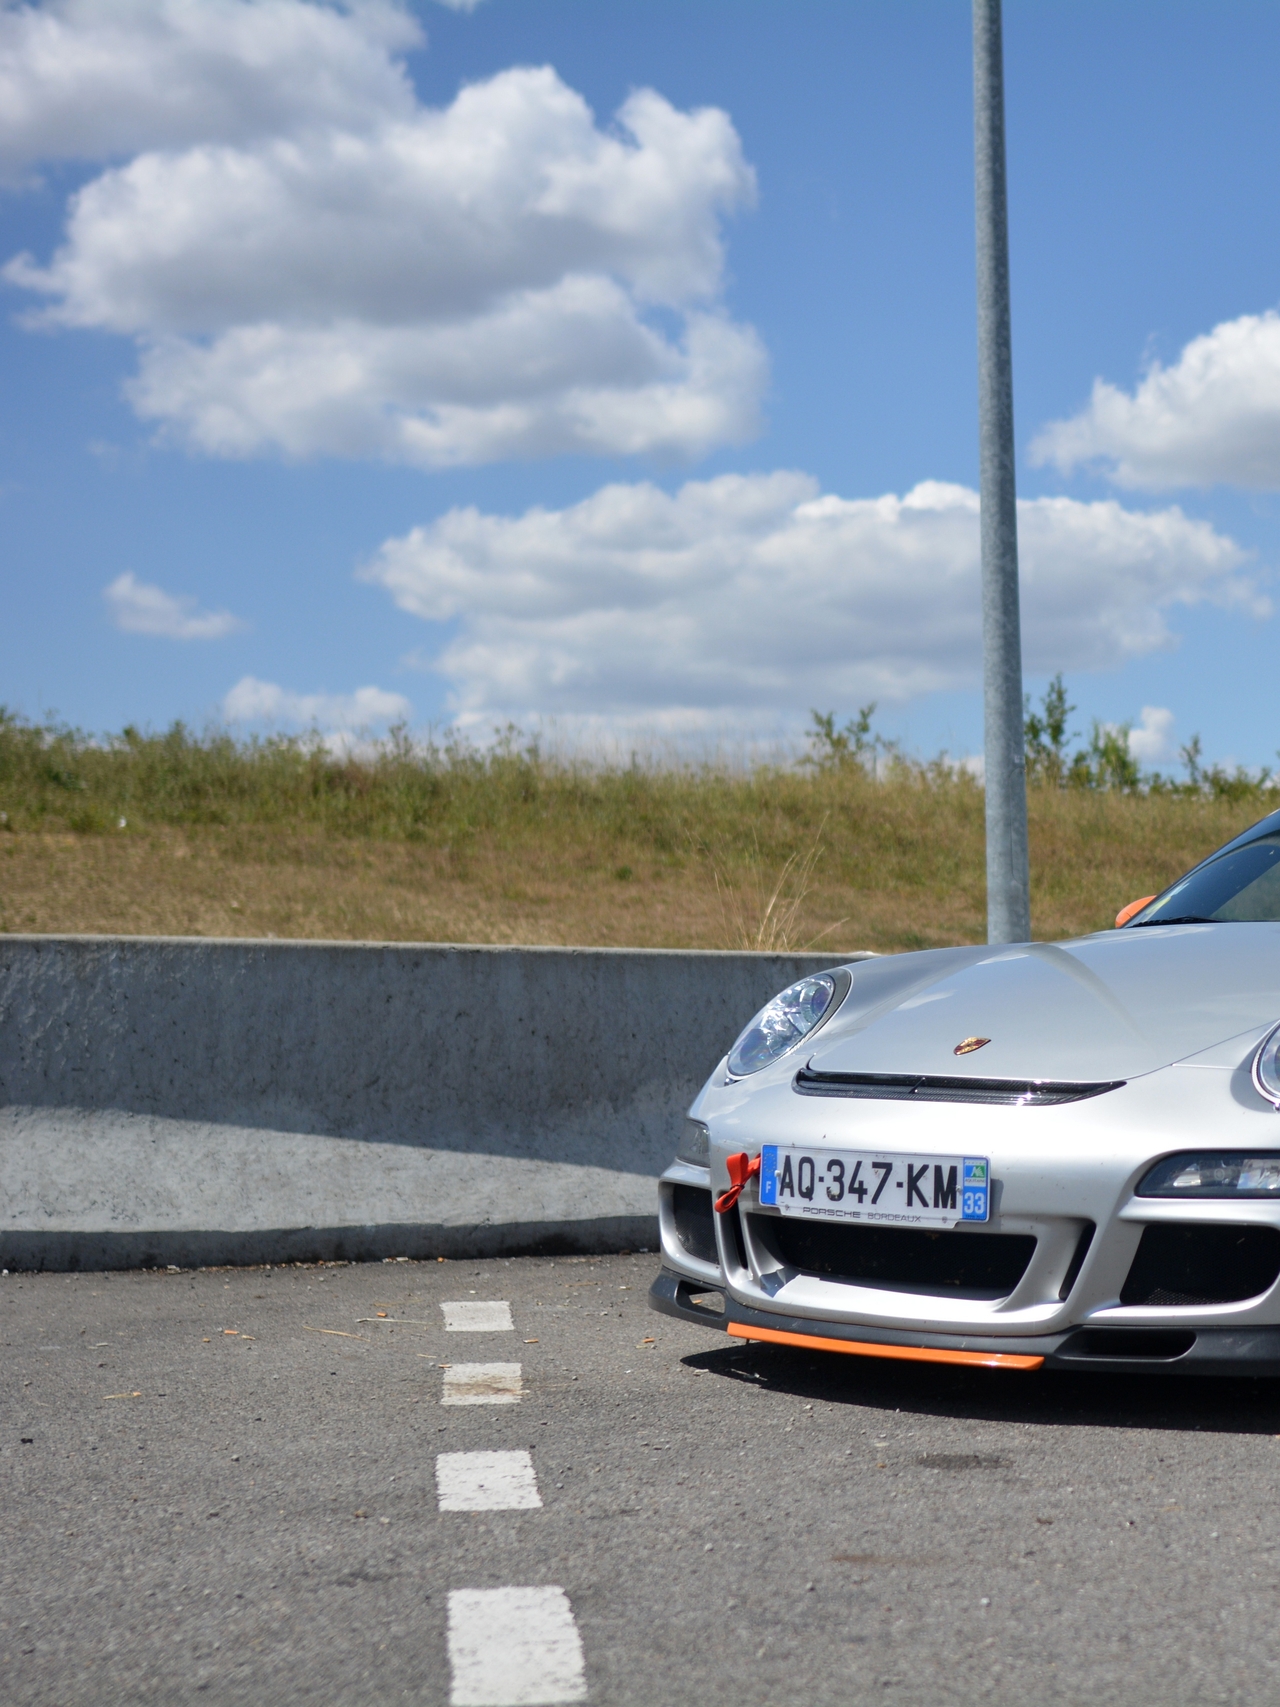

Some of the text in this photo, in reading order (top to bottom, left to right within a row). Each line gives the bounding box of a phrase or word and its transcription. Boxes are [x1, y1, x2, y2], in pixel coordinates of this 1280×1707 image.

[765, 1181, 772, 1194] F
[964, 1192, 985, 1214] 33
[802, 1206, 922, 1223] PORSCHE BORDEAUX
